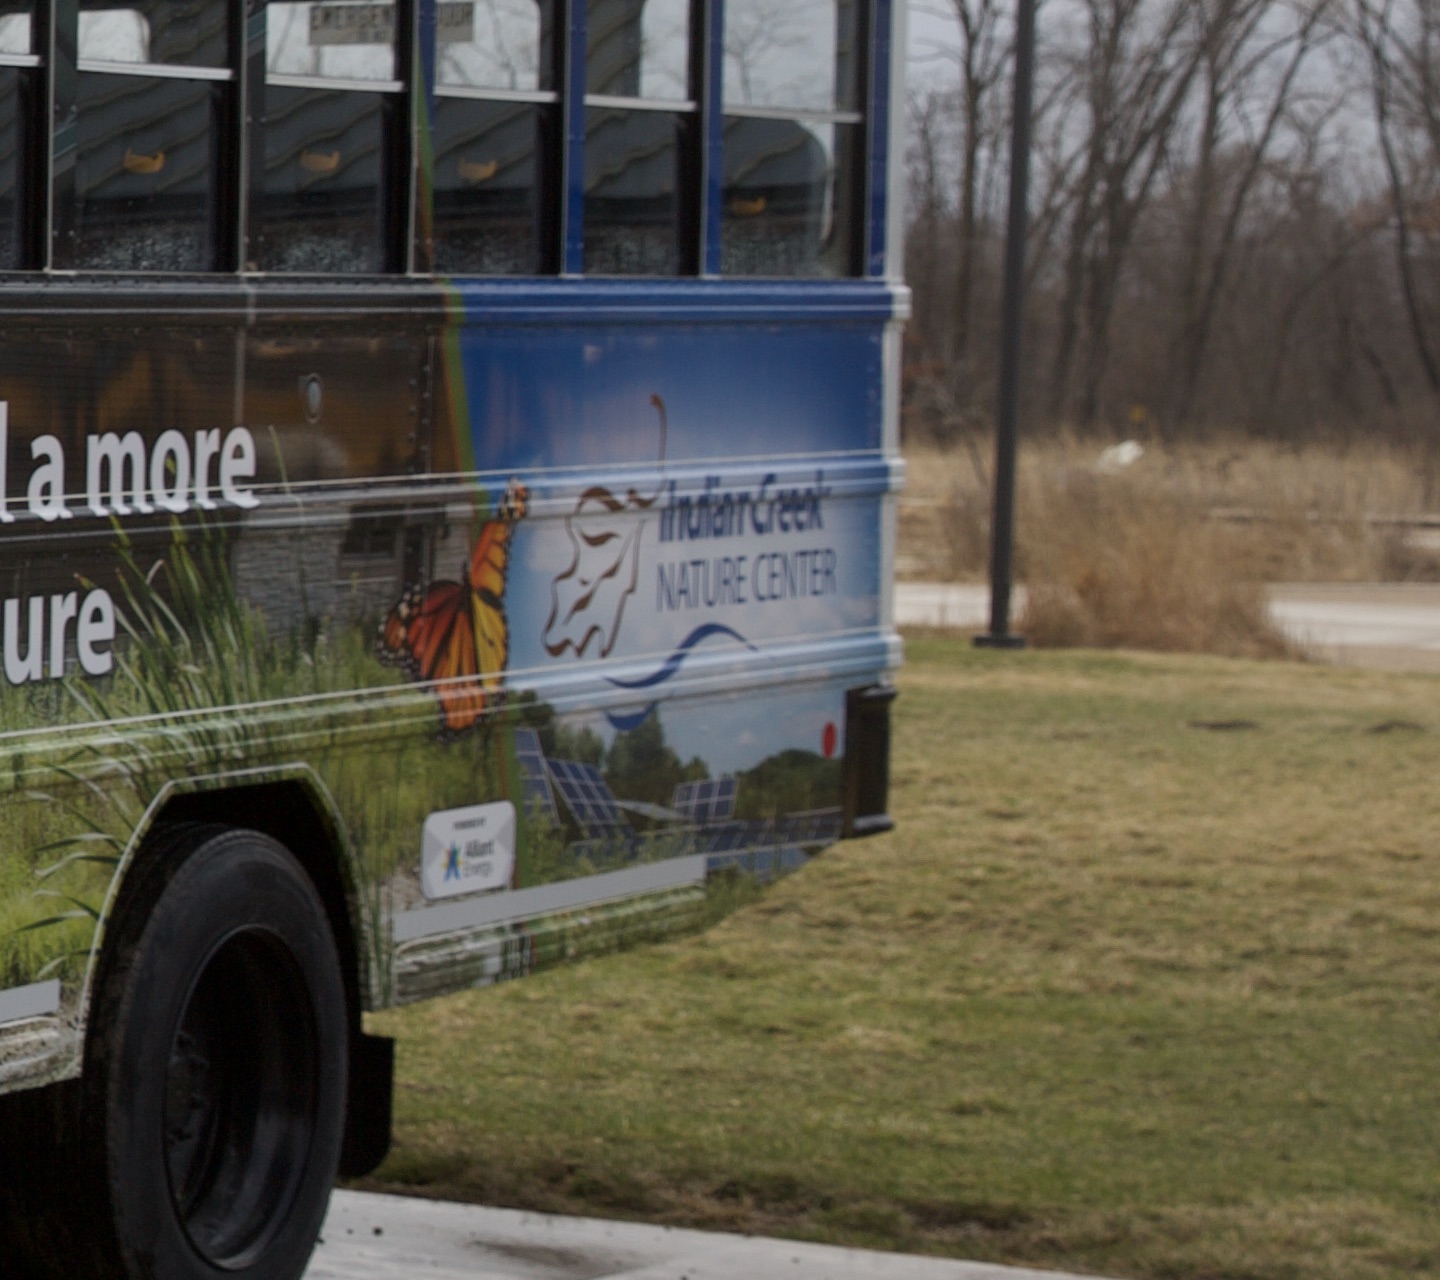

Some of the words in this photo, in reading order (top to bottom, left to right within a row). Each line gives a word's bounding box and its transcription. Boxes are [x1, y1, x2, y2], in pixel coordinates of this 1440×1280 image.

[28, 434, 73, 521] a
[86, 424, 261, 515] more
[658, 476, 750, 543] Indian
[752, 470, 832, 534] Creek
[656, 552, 748, 612] NATURE
[750, 548, 837, 603] CENTER
